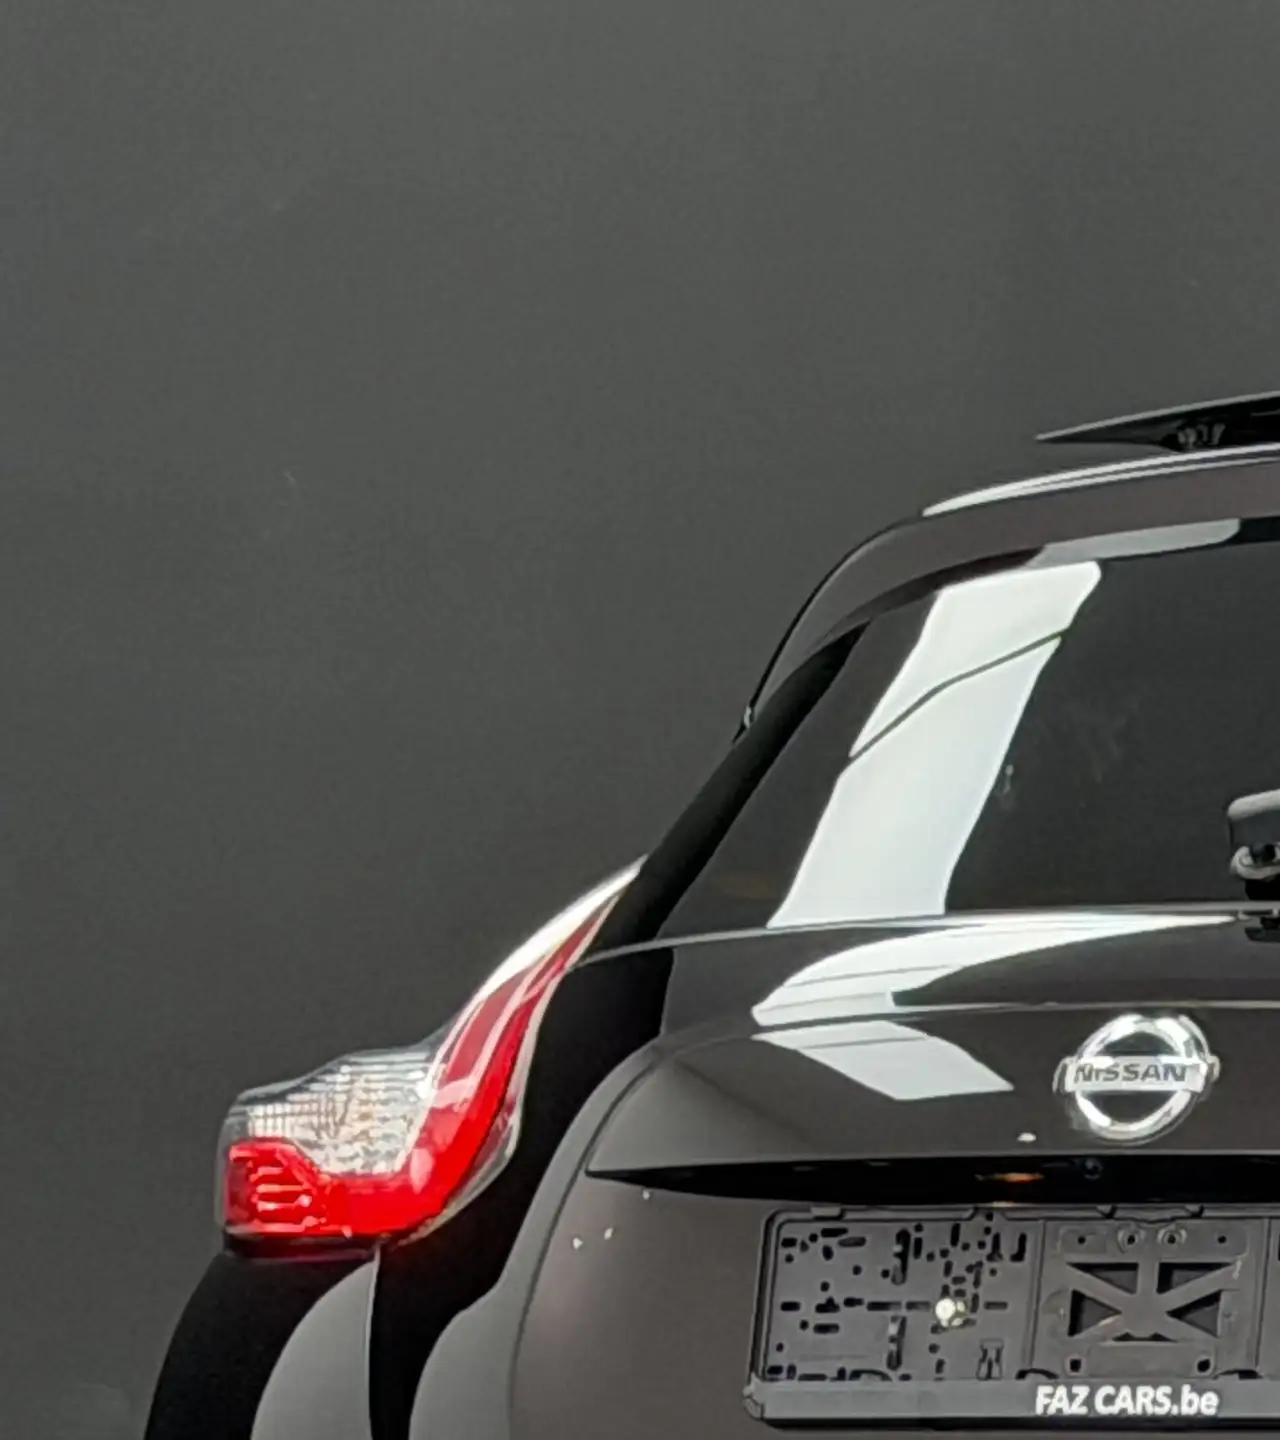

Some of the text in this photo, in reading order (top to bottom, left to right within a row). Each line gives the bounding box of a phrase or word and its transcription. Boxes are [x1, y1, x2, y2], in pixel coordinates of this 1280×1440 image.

[1074, 1062, 1188, 1083] NISSAN
[1035, 1383, 1220, 1416] FAZ CARS.be
